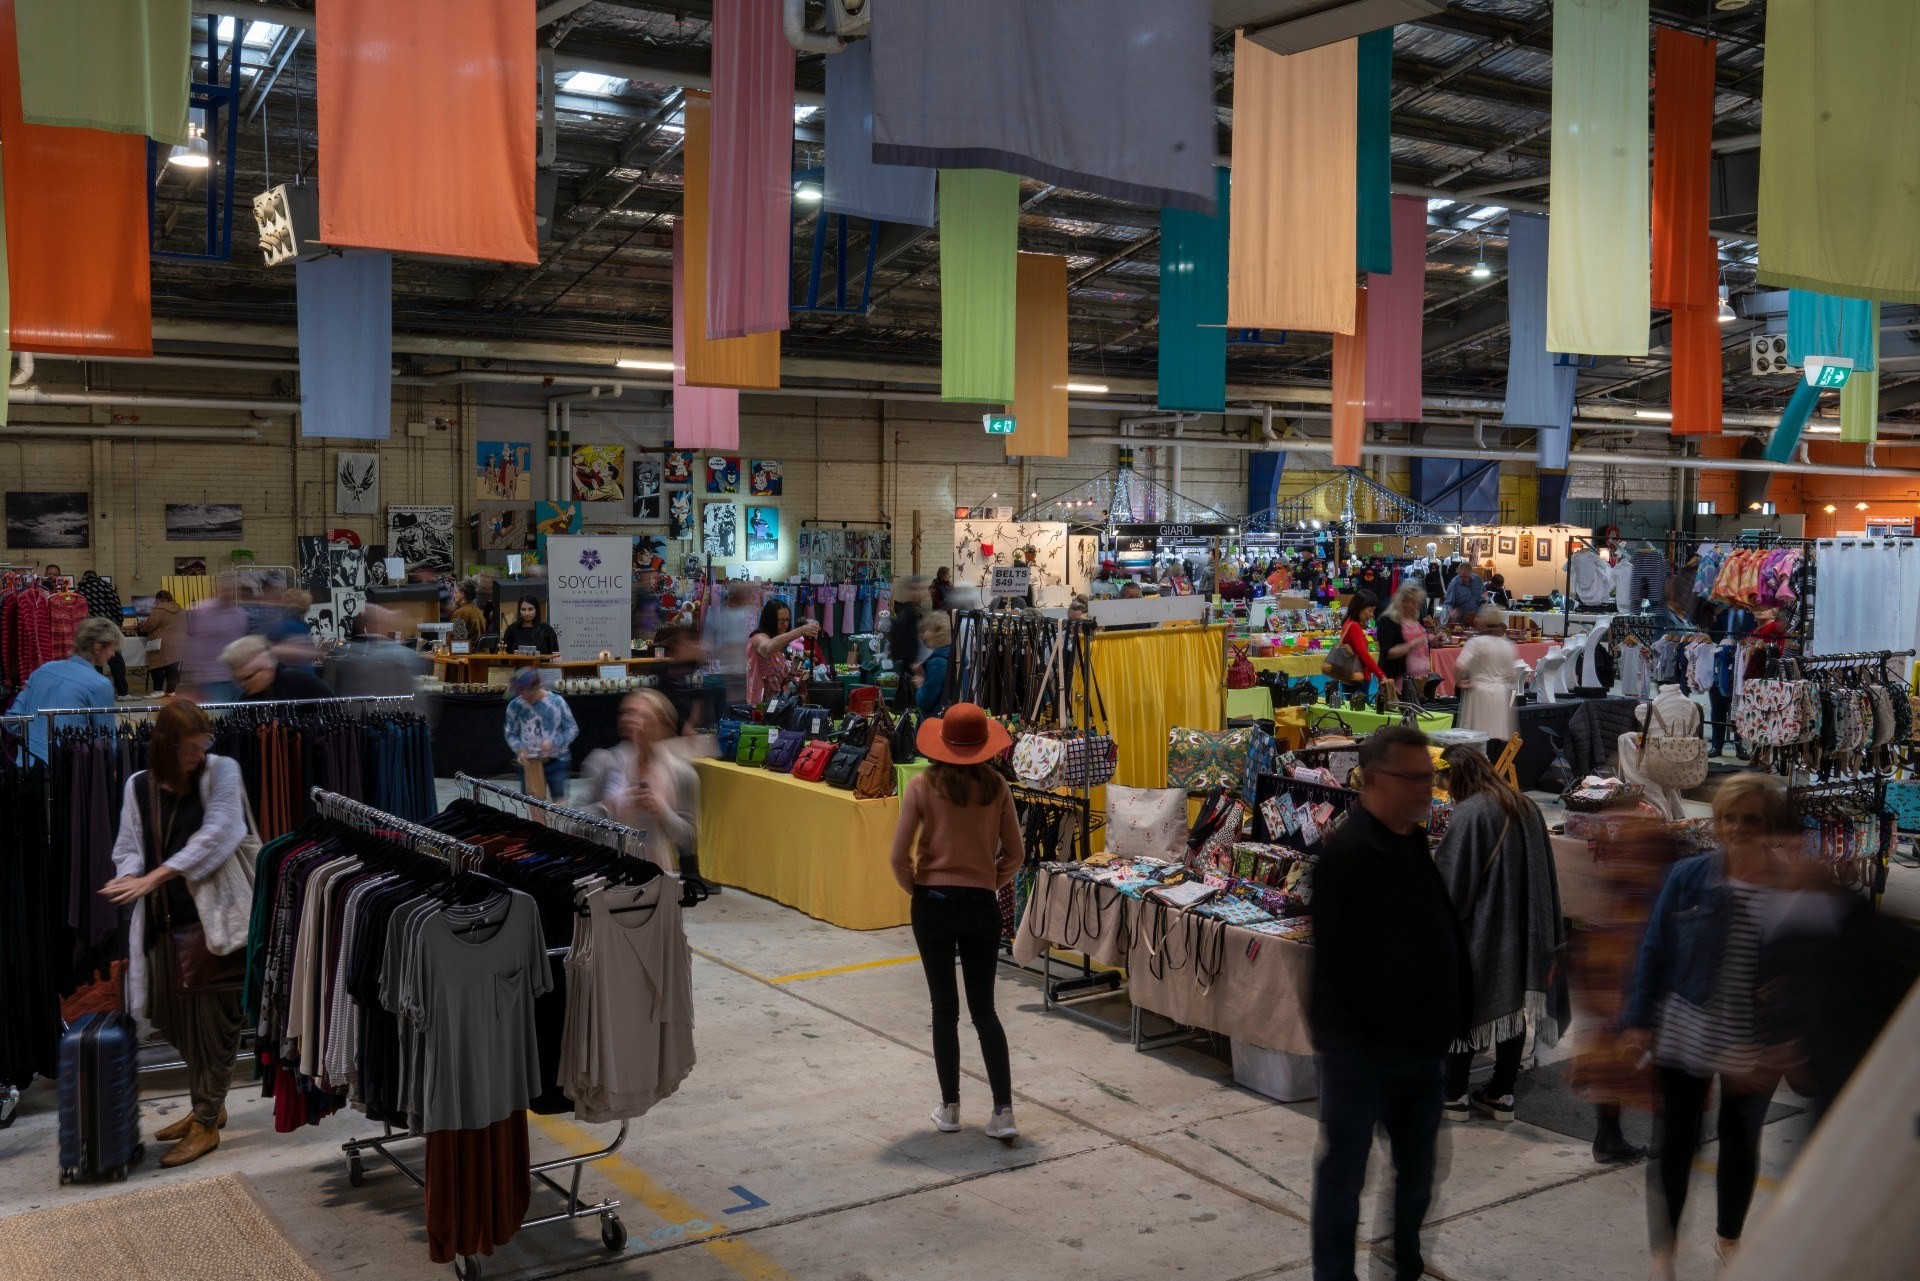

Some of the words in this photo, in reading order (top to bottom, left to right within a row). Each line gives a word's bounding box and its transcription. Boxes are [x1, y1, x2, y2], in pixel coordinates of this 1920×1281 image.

[1160, 525, 1193, 536] GIARDI
[1395, 524, 1422, 535] GIARDI
[749, 542, 775, 558] PHANTOM
[996, 570, 1028, 578] BELTS
[558, 575, 623, 589] SOYCHIC
[995, 578, 1013, 587] $49
